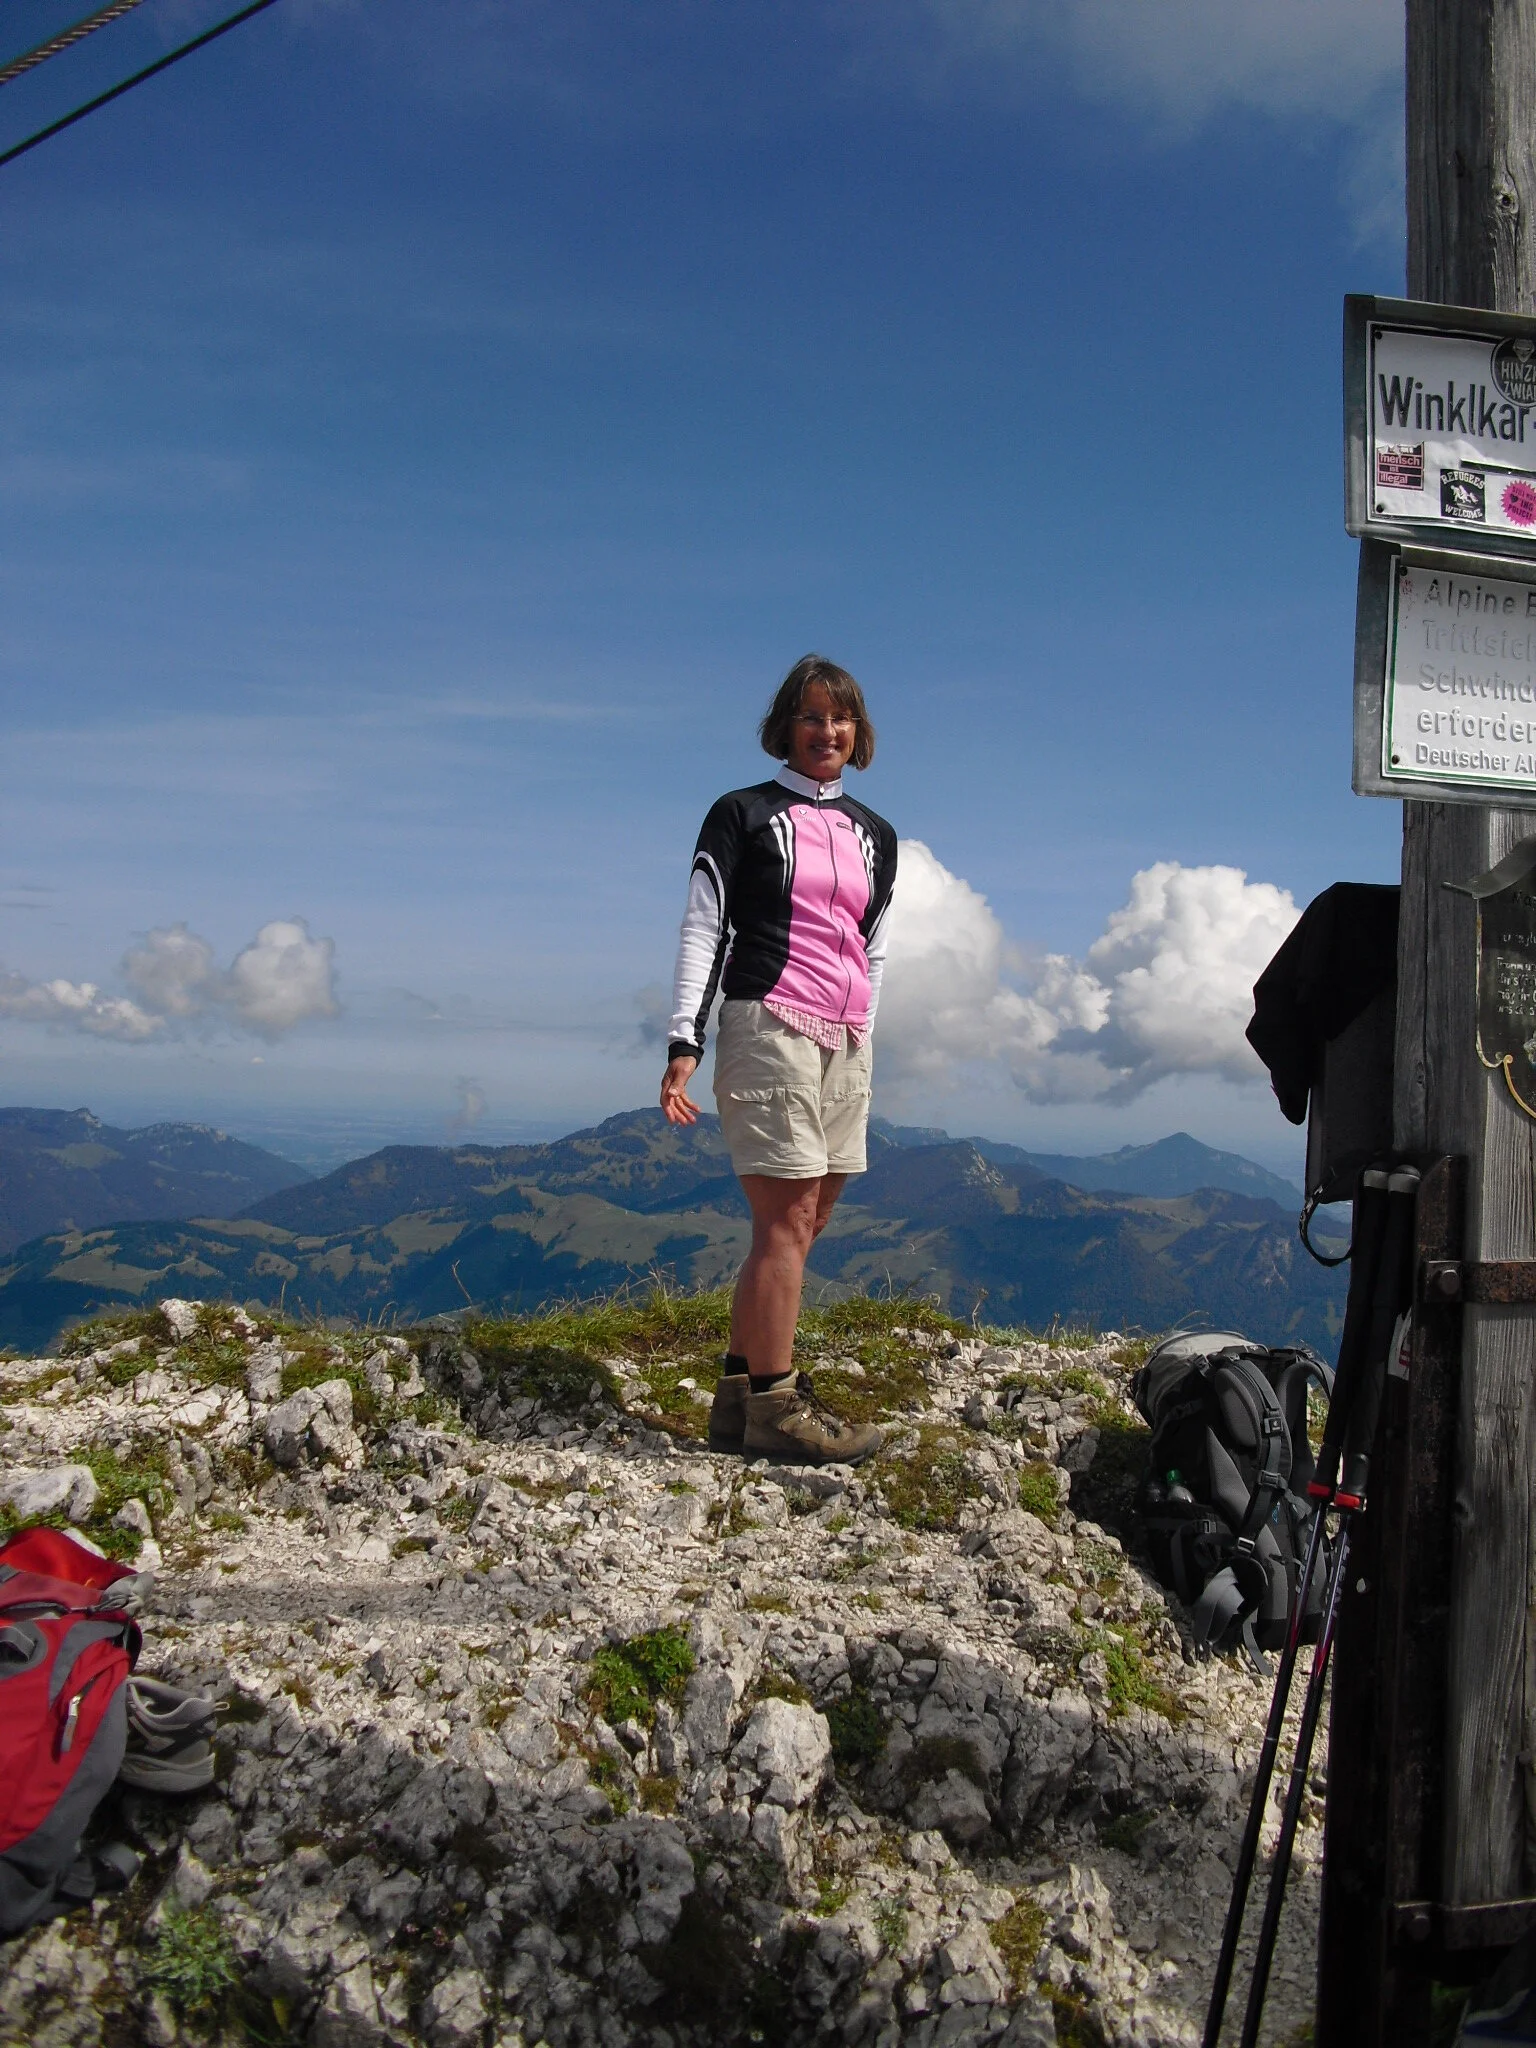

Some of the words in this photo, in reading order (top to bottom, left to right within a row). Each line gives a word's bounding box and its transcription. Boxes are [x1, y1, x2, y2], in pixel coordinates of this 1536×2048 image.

[1503, 381, 1536, 400] ZWIA
[1380, 454, 1420, 466] mensch
[1380, 473, 1408, 486] illegal
[1441, 471, 1485, 490] REFUGEES
[1445, 504, 1483, 519] WELCOME
[1424, 579, 1515, 617] Alpine
[1419, 662, 1536, 703] Schwind
[1416, 742, 1510, 771] Deutscher
[1514, 753, 1536, 775] Al
